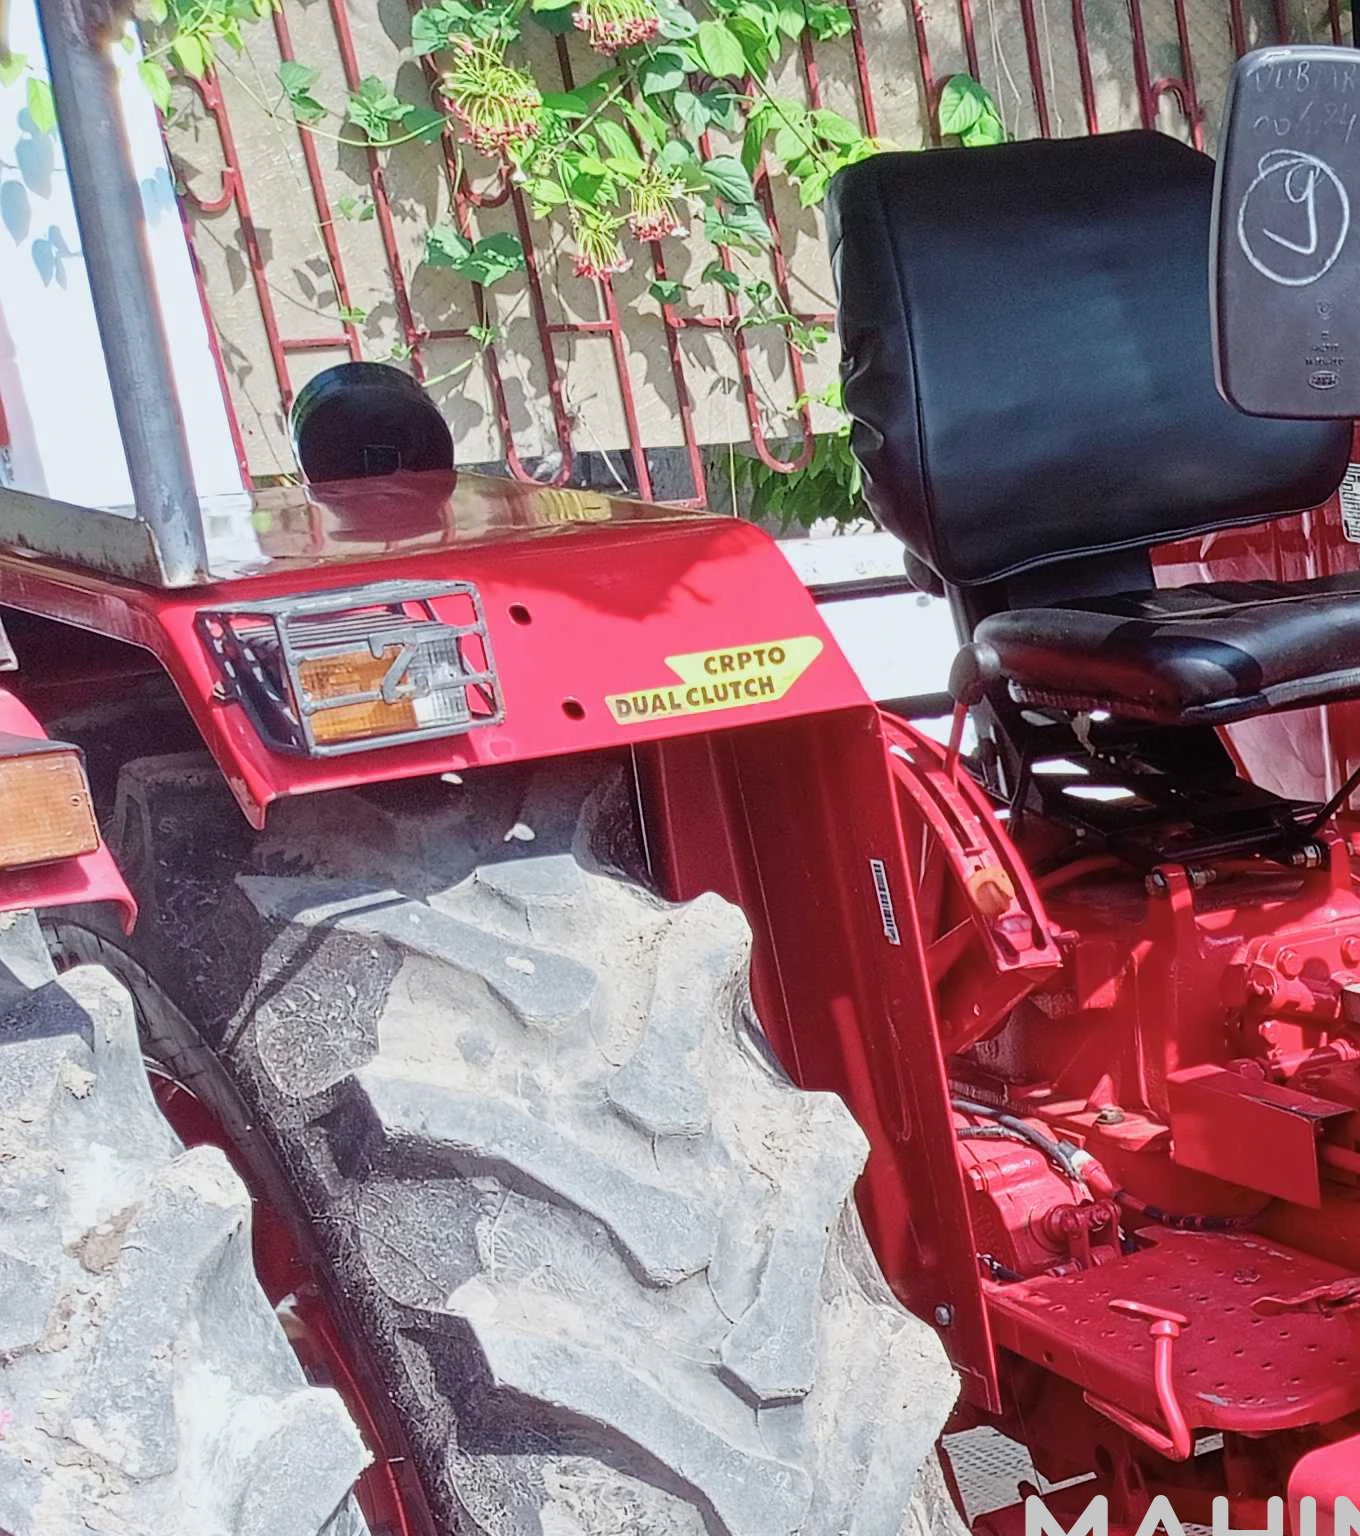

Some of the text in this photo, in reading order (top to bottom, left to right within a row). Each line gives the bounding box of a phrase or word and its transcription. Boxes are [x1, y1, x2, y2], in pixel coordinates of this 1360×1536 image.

[703, 646, 786, 675] CRPTO
[614, 675, 776, 718] DUAL CLUTCH
